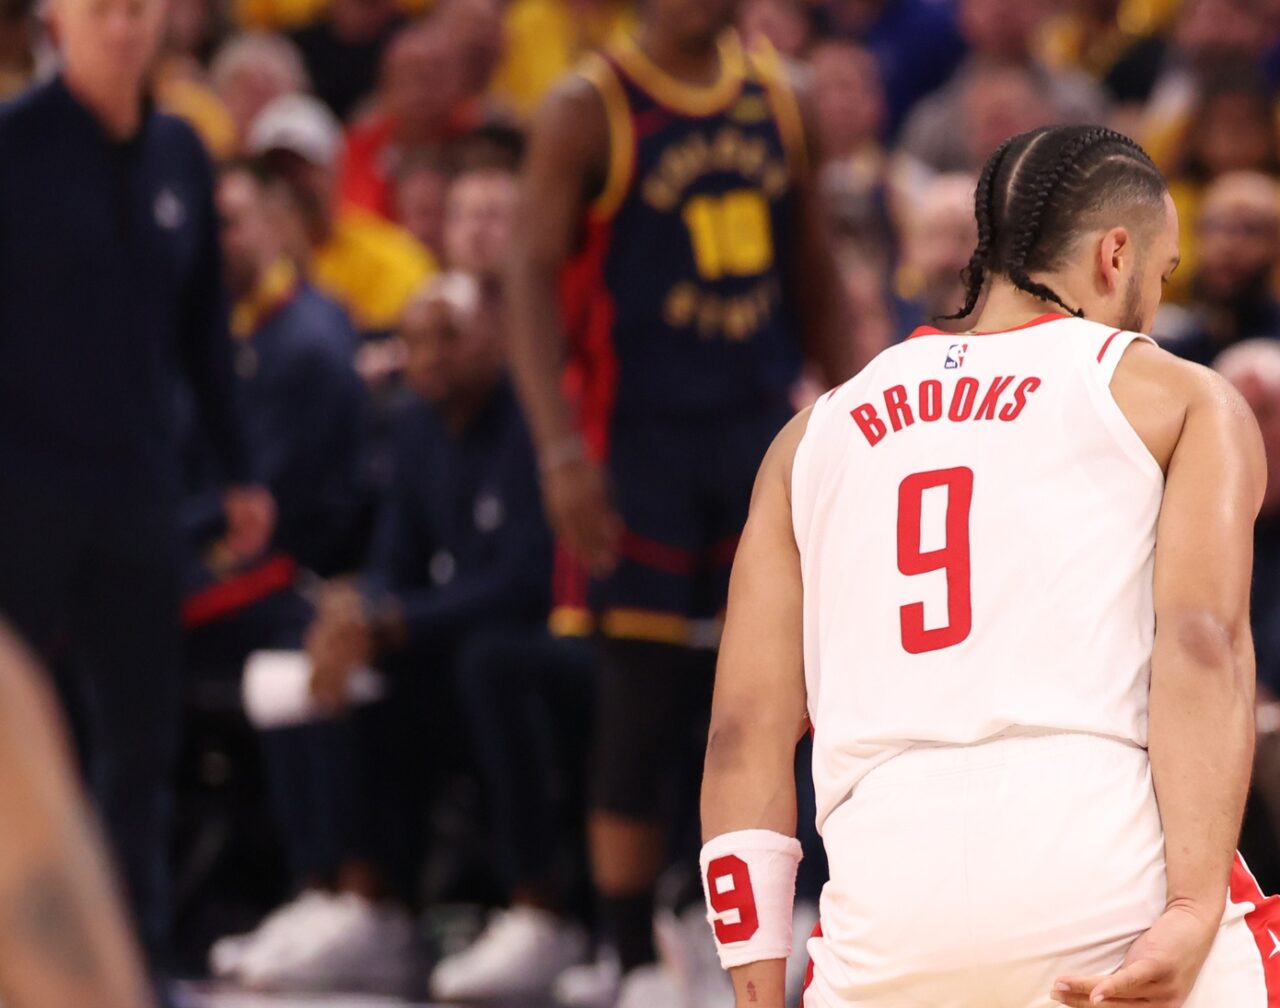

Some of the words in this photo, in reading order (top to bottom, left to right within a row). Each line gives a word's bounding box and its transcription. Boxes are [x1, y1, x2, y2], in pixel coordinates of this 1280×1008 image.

[850, 376, 1041, 447] BROOKS
[897, 466, 973, 654] 9
[707, 854, 759, 944] 9
